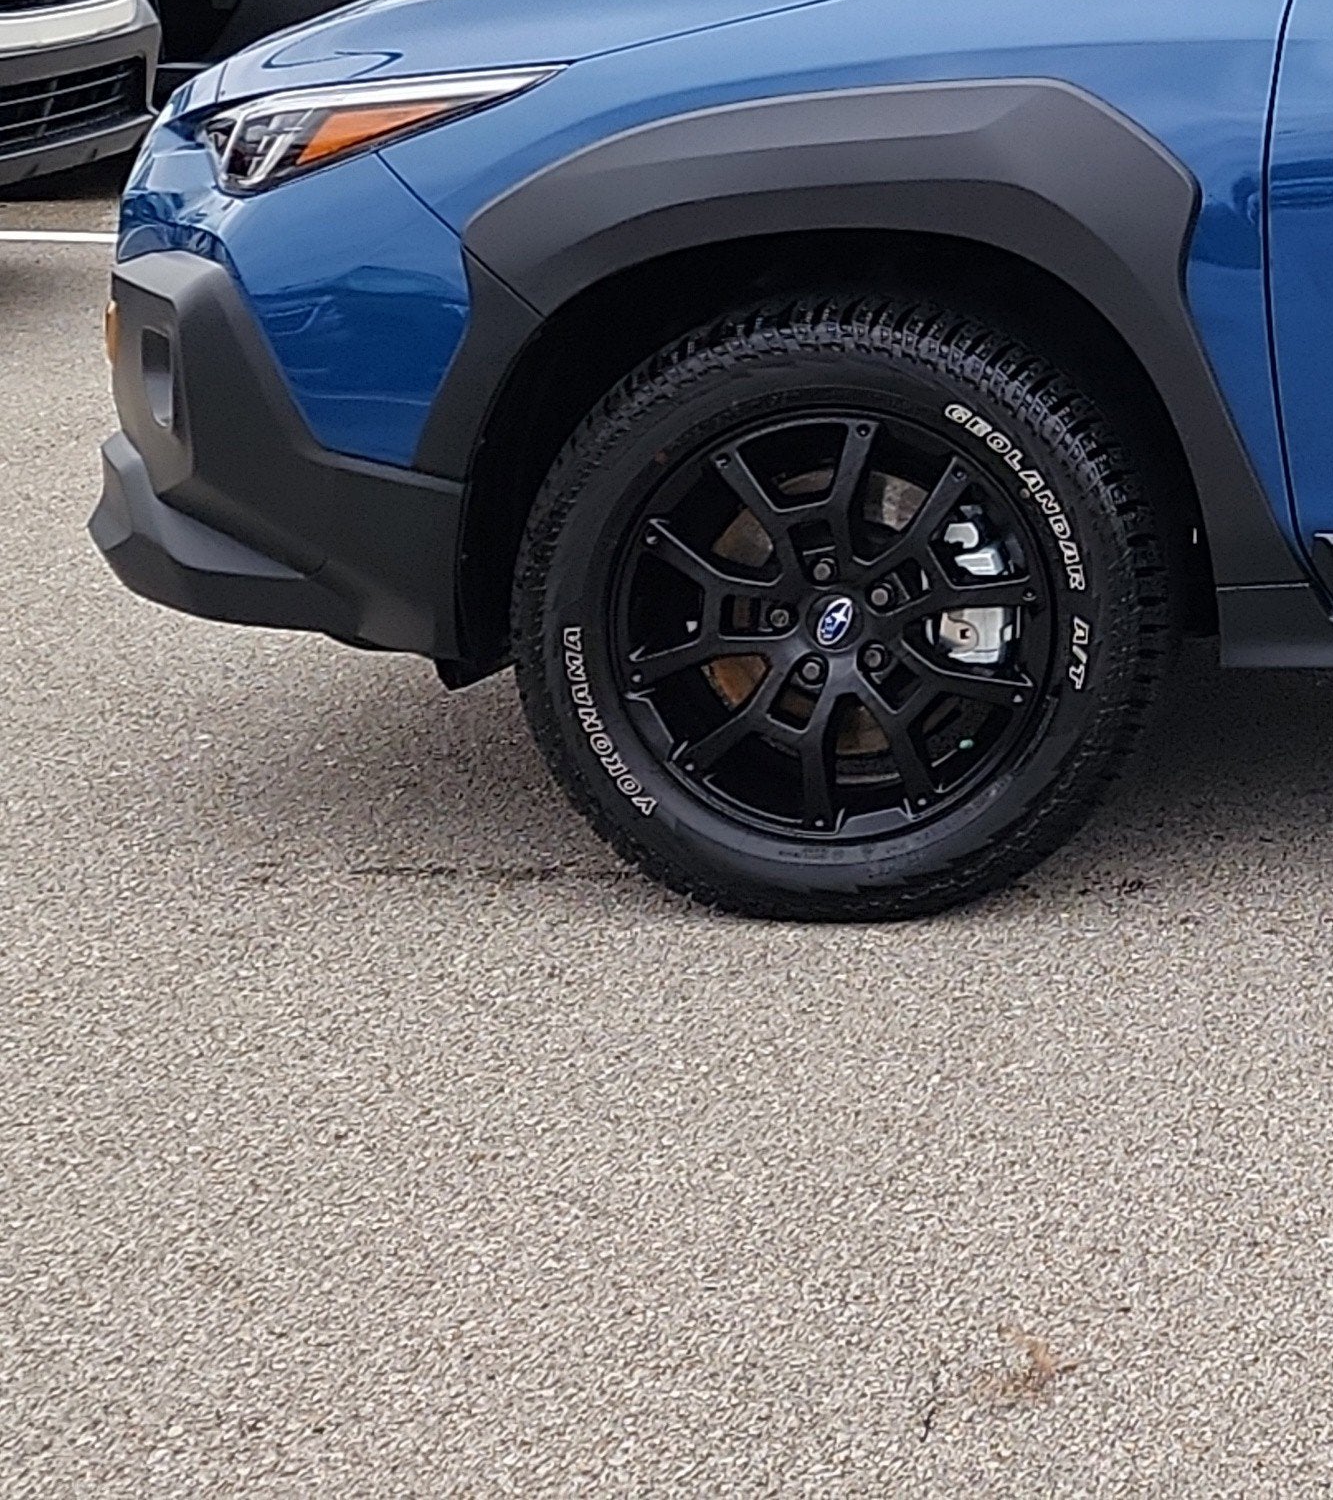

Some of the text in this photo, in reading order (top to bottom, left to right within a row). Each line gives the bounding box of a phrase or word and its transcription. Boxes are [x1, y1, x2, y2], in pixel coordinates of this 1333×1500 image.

[944, 403, 1091, 690] GEOLANDAR A/T
[563, 626, 658, 816] YOKOHAMA
